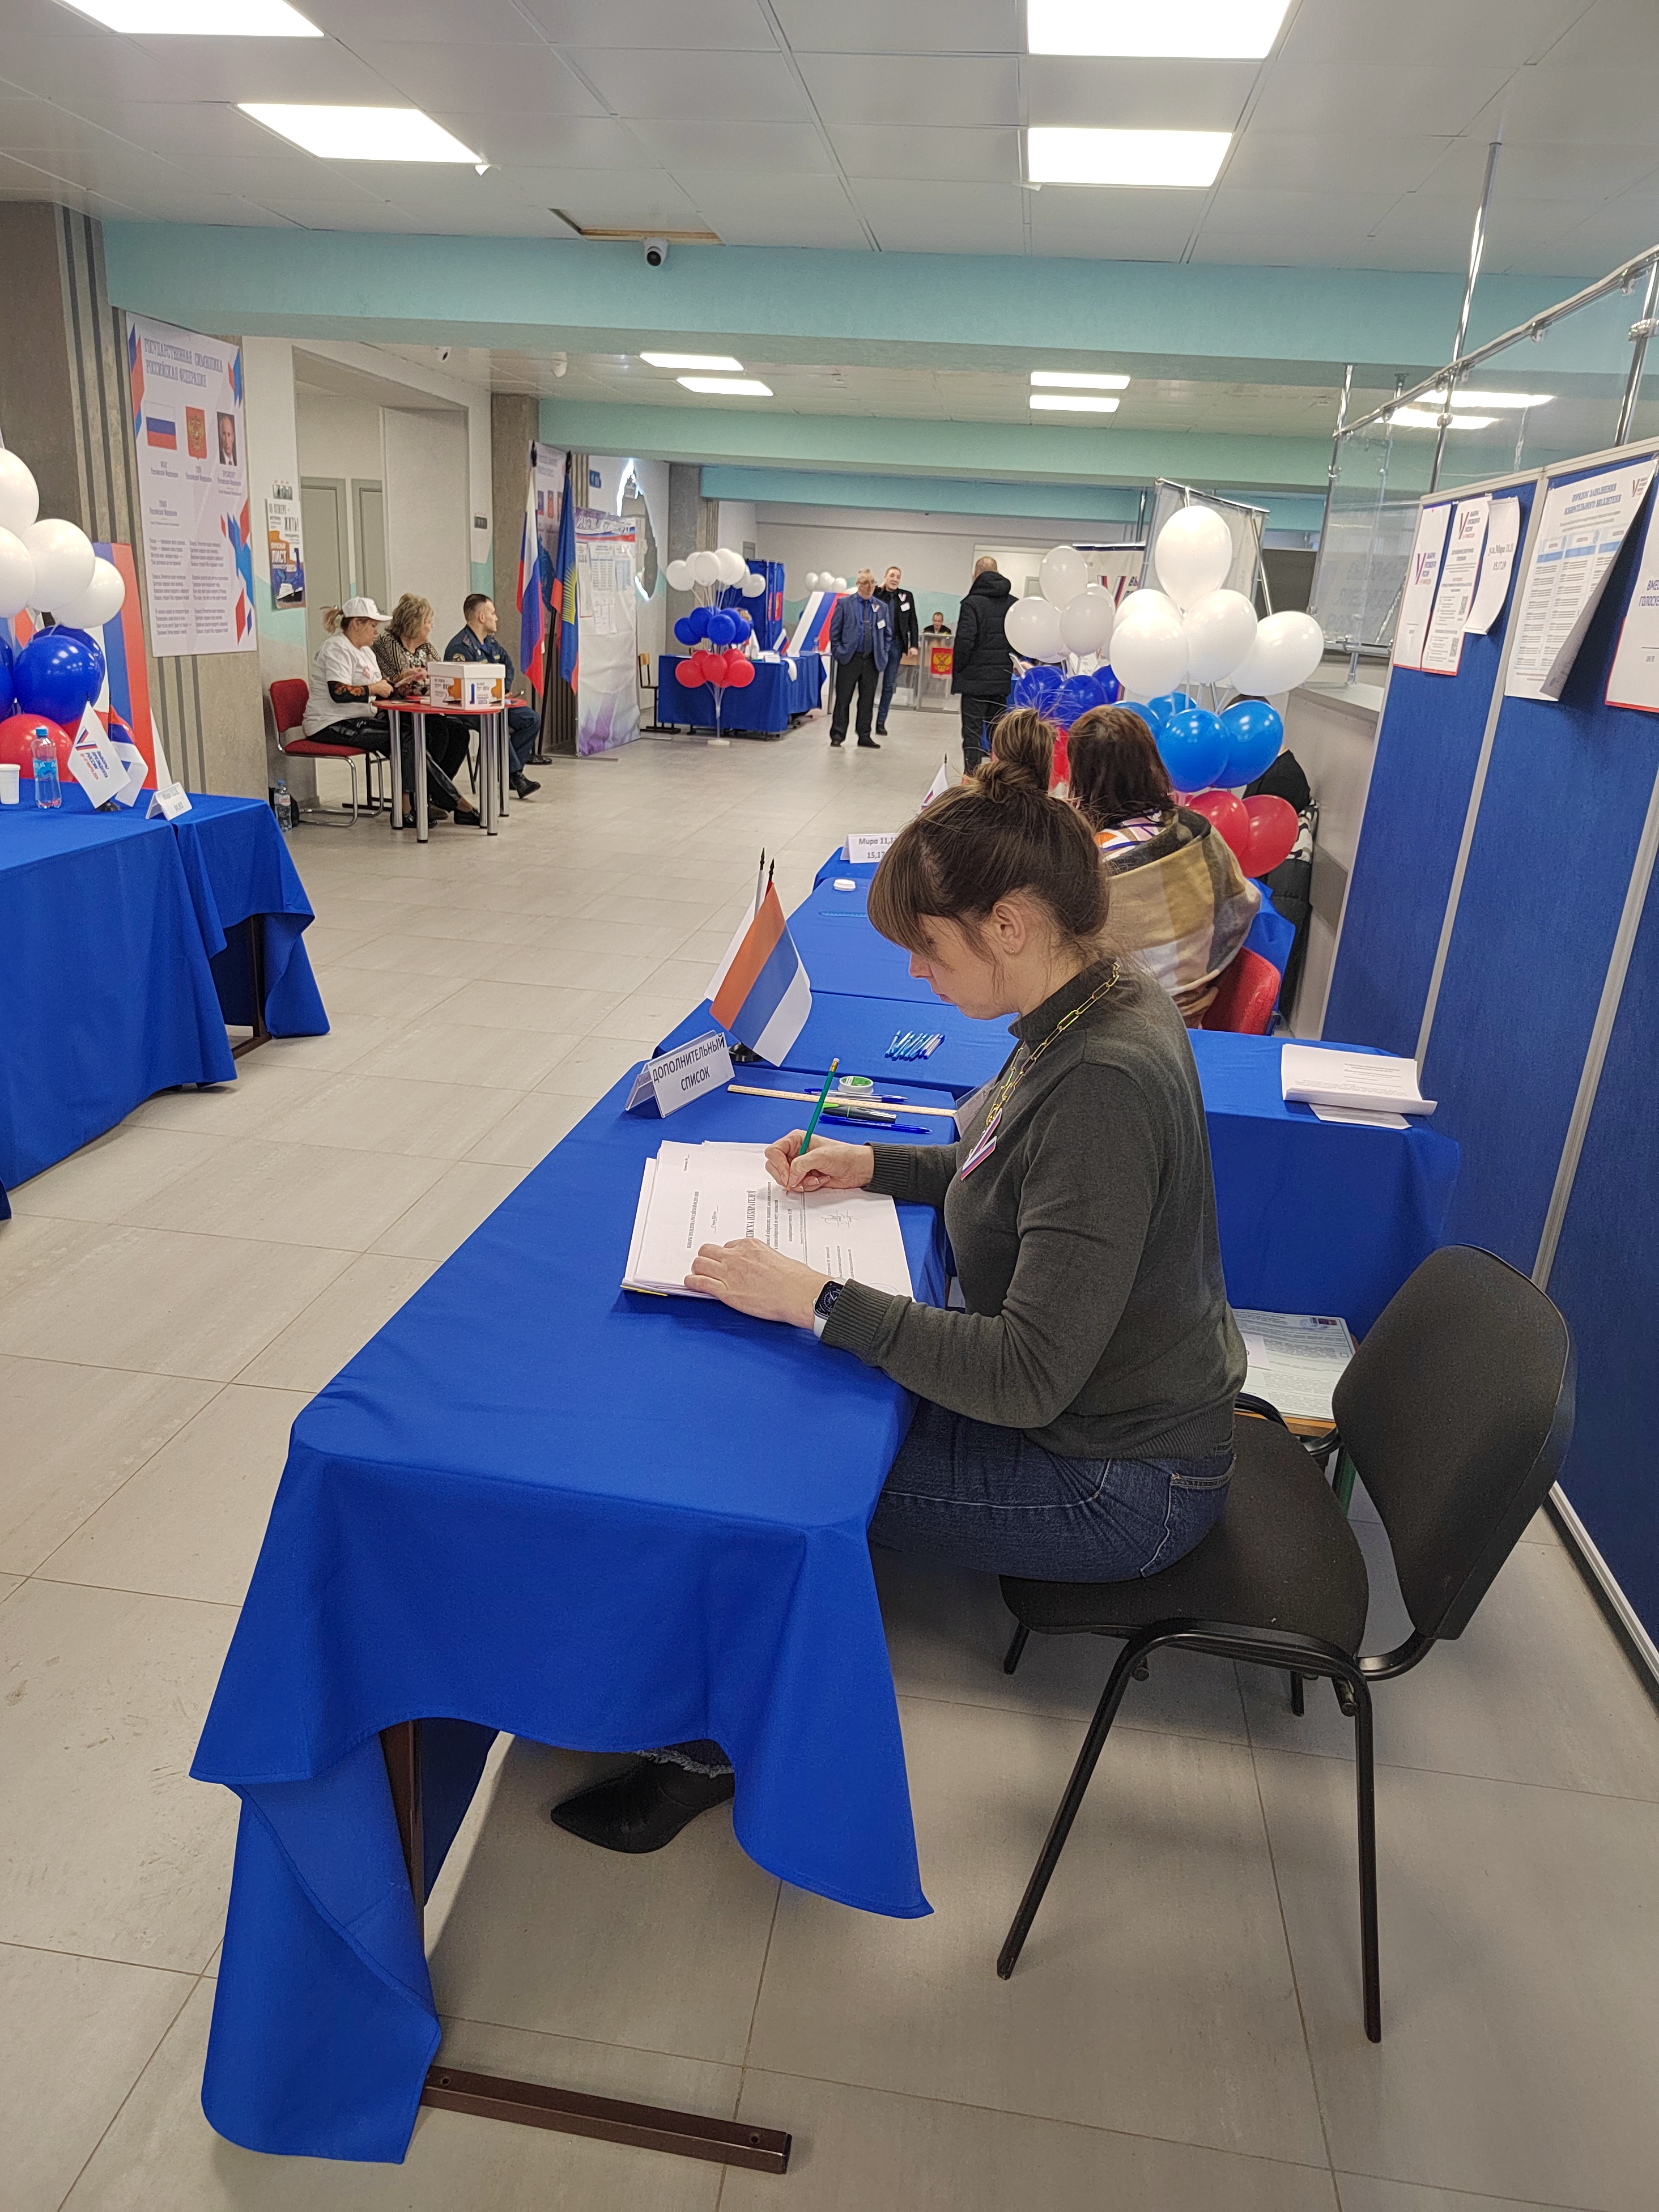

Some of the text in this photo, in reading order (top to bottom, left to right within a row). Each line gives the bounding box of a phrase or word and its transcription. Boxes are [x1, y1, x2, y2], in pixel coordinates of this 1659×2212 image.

[271, 550, 287, 563] ЛИСТ
[85, 752, 98, 769] РОССИИ
[858, 837, 878, 846] Мира
[652, 1033, 725, 1084] ДОПОЛНИТЕЛЬНЫЙ
[680, 1066, 710, 1091] СПИСОК
[746, 1190, 756, 1238] ПИСКА ИЗБИРАТЕЛЕЙ
